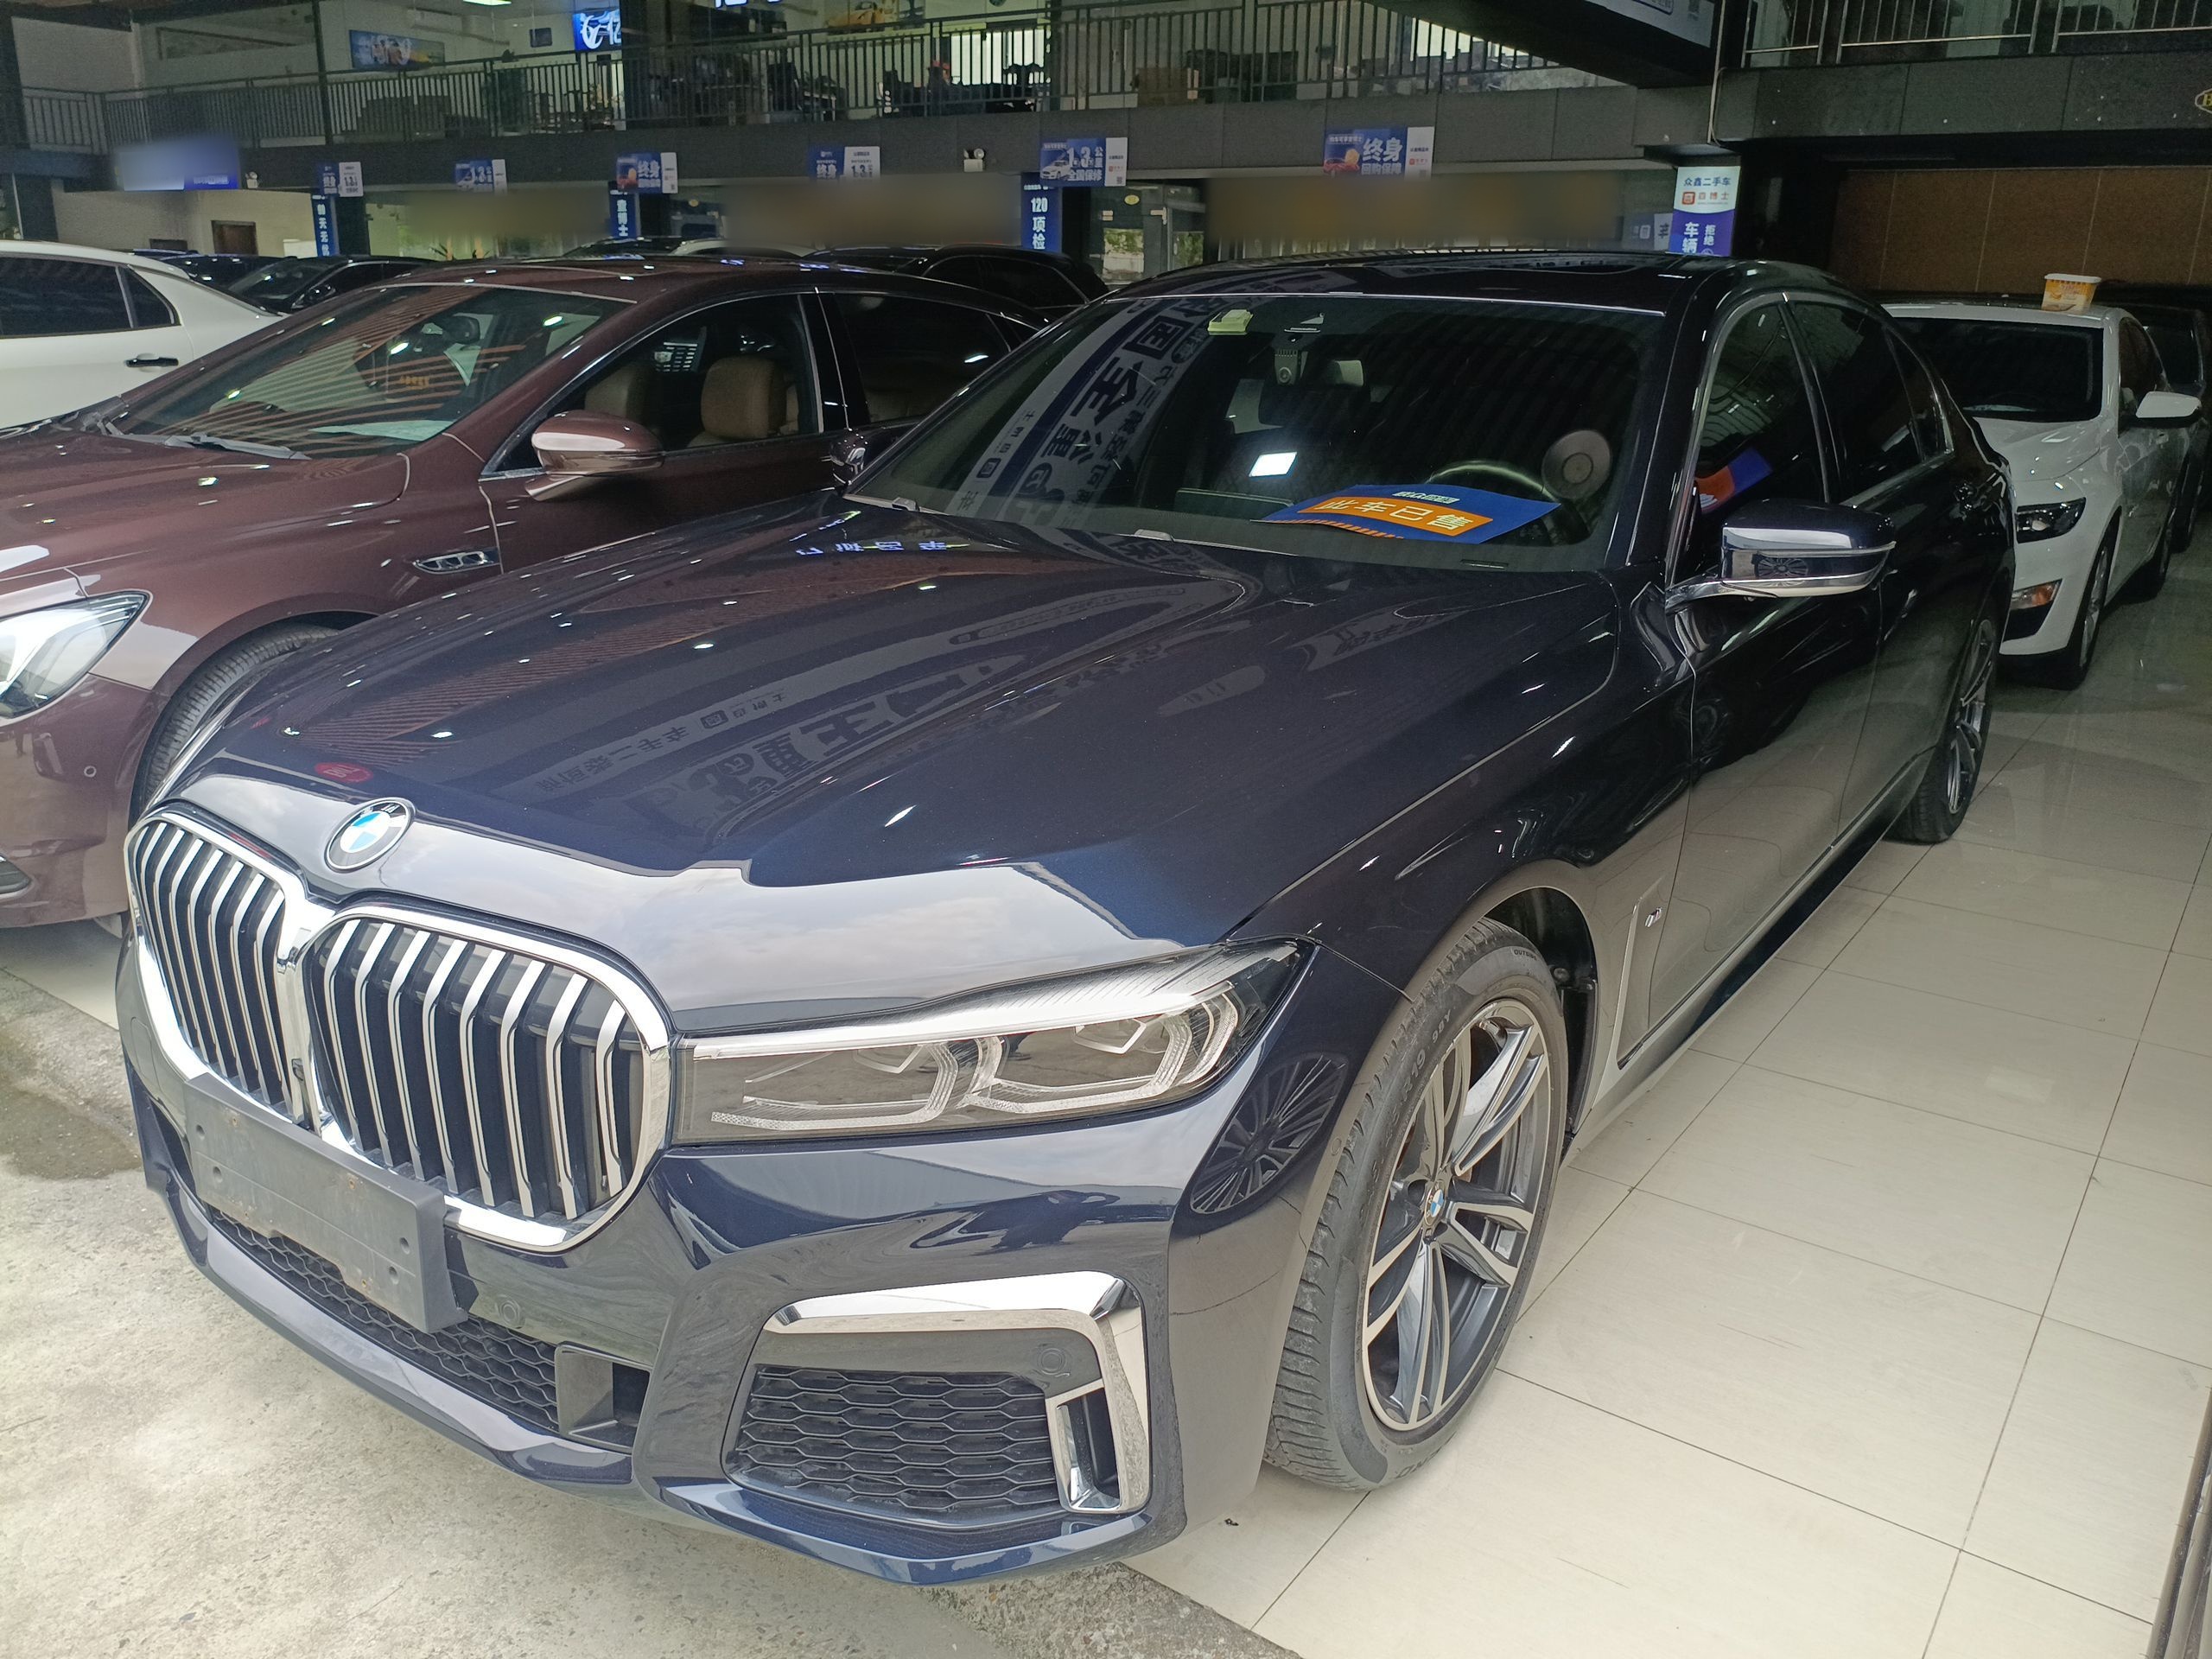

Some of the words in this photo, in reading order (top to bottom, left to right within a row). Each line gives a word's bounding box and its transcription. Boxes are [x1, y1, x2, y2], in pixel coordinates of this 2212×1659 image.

[1362, 137, 1403, 162] 终身
[1684, 177, 1731, 187] 众鑫二手车
[1314, 499, 1473, 531] 此车已售
